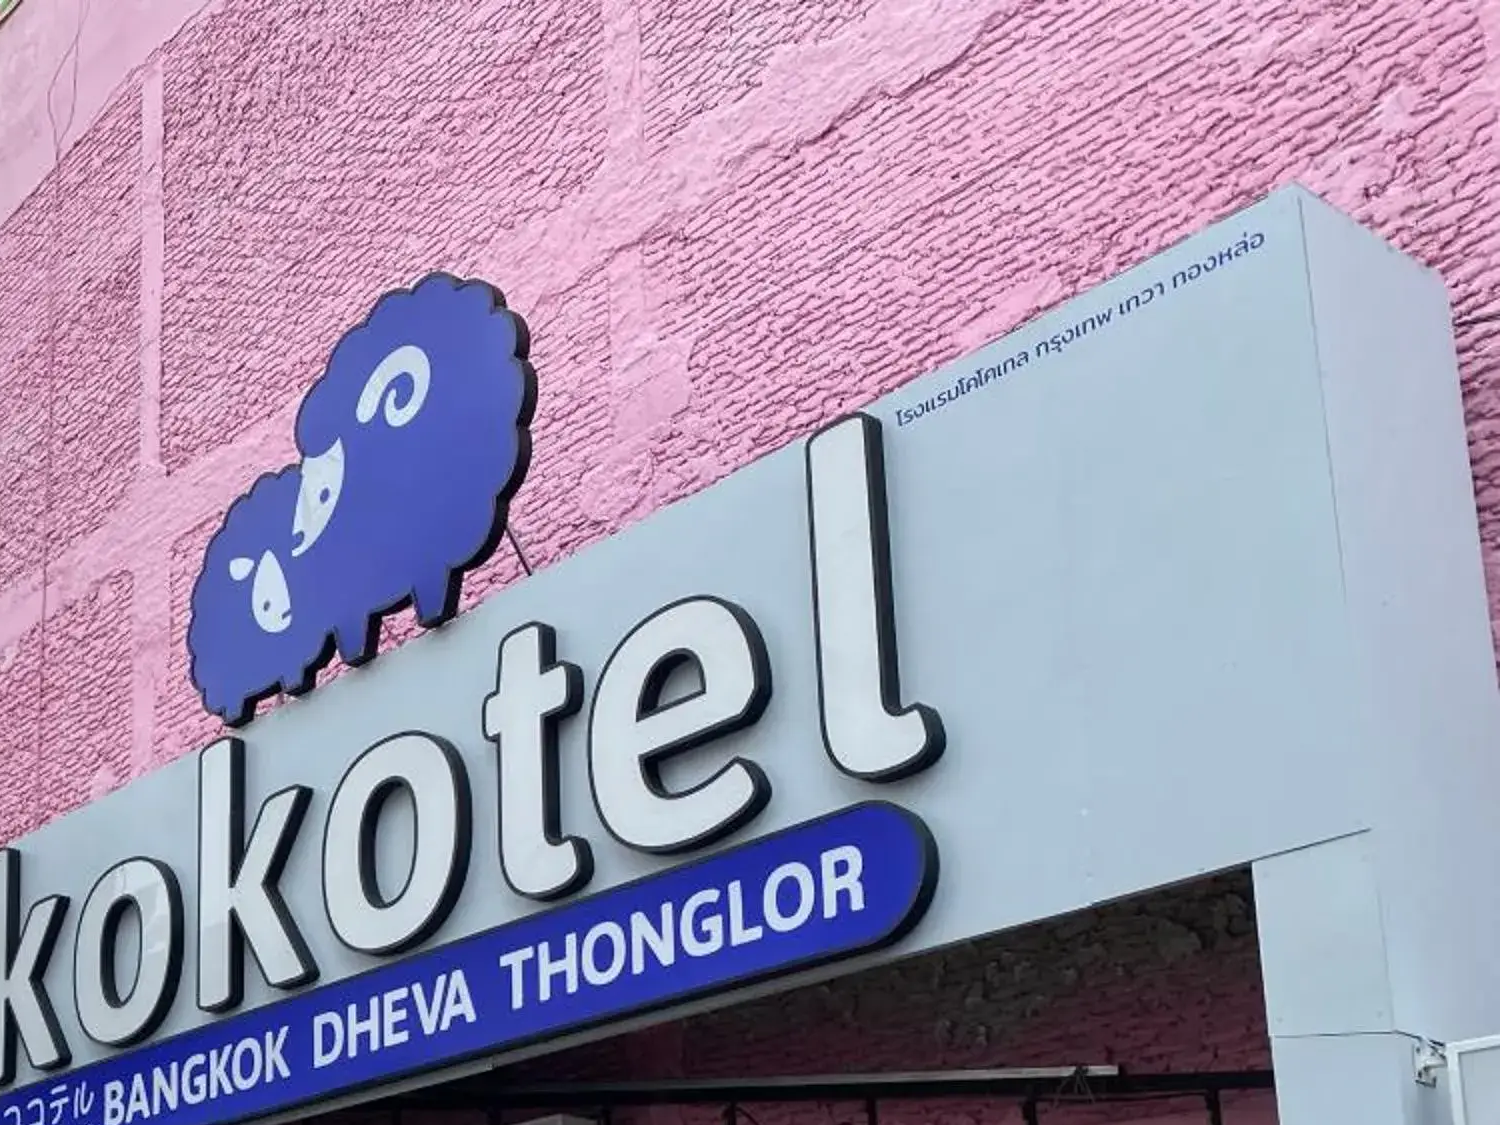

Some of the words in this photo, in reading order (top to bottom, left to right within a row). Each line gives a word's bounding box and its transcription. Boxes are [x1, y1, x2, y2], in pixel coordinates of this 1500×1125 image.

[1035, 307, 1112, 358] กรุงเทพ
[1119, 281, 1165, 315] เทวา
[1172, 231, 1265, 289] ทองหล่อ
[311, 968, 477, 1069] DHEVA
[500, 844, 865, 1010] THONGLOR
